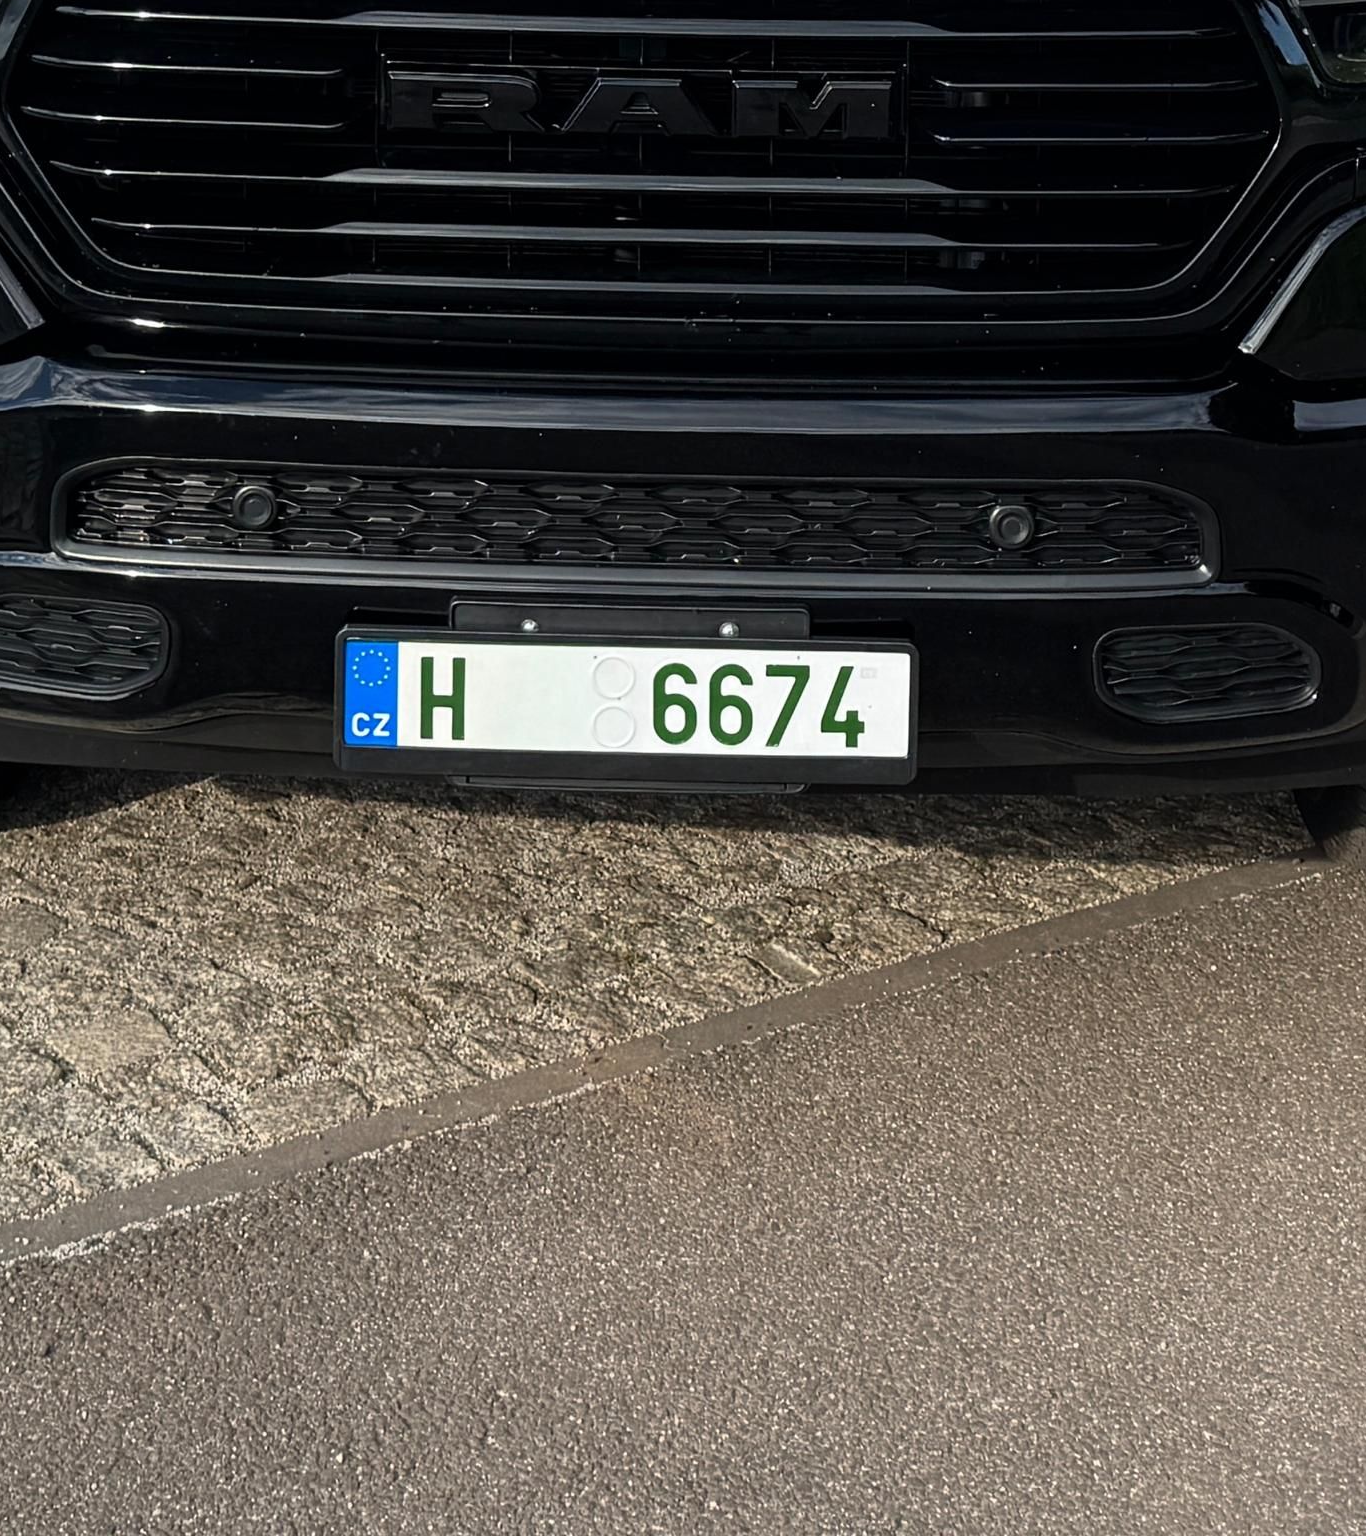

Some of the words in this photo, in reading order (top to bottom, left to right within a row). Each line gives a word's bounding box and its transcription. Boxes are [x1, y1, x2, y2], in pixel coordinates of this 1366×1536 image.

[388, 71, 892, 138] RAM
[351, 713, 390, 737] CZ
[420, 657, 466, 740] H
[652, 662, 865, 748] 6674
